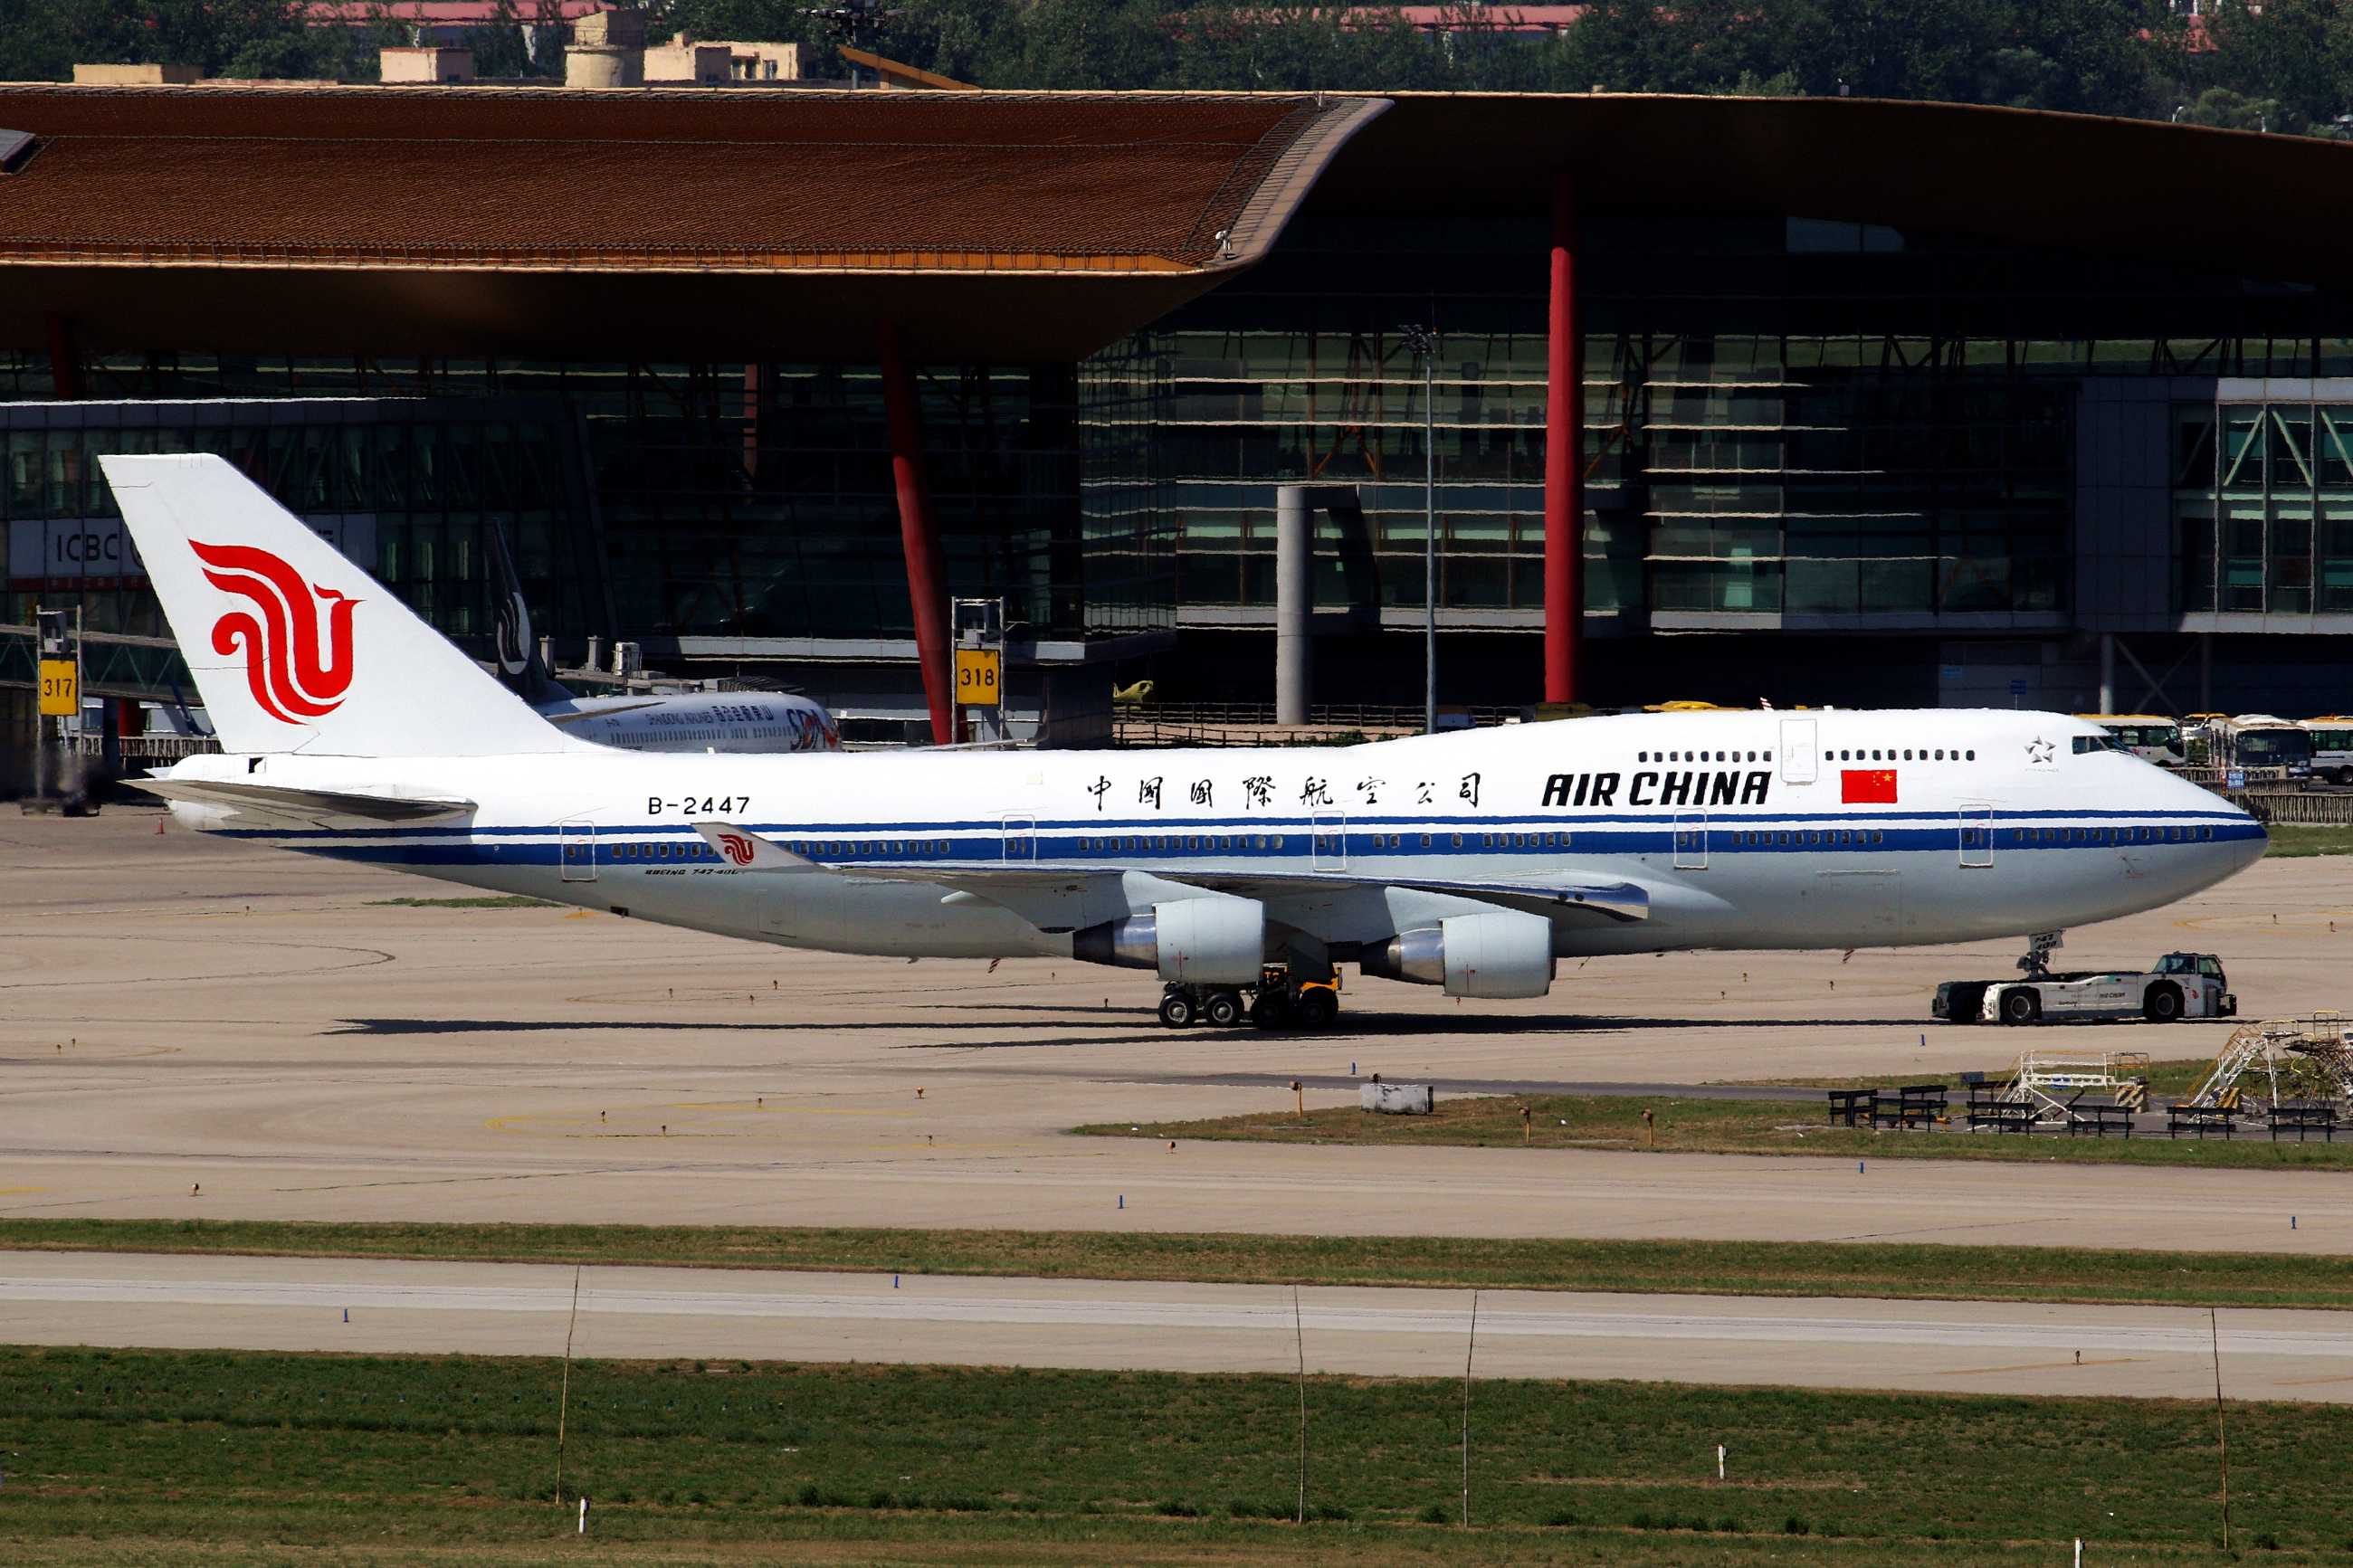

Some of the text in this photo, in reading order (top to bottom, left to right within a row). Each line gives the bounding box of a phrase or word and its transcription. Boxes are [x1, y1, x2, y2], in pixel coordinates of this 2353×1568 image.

[57, 533, 119, 562] ICBC
[960, 668, 995, 687] 318
[43, 679, 73, 698] 317
[1541, 771, 1772, 806] AIR CHINA
[648, 796, 751, 815] B-2447
